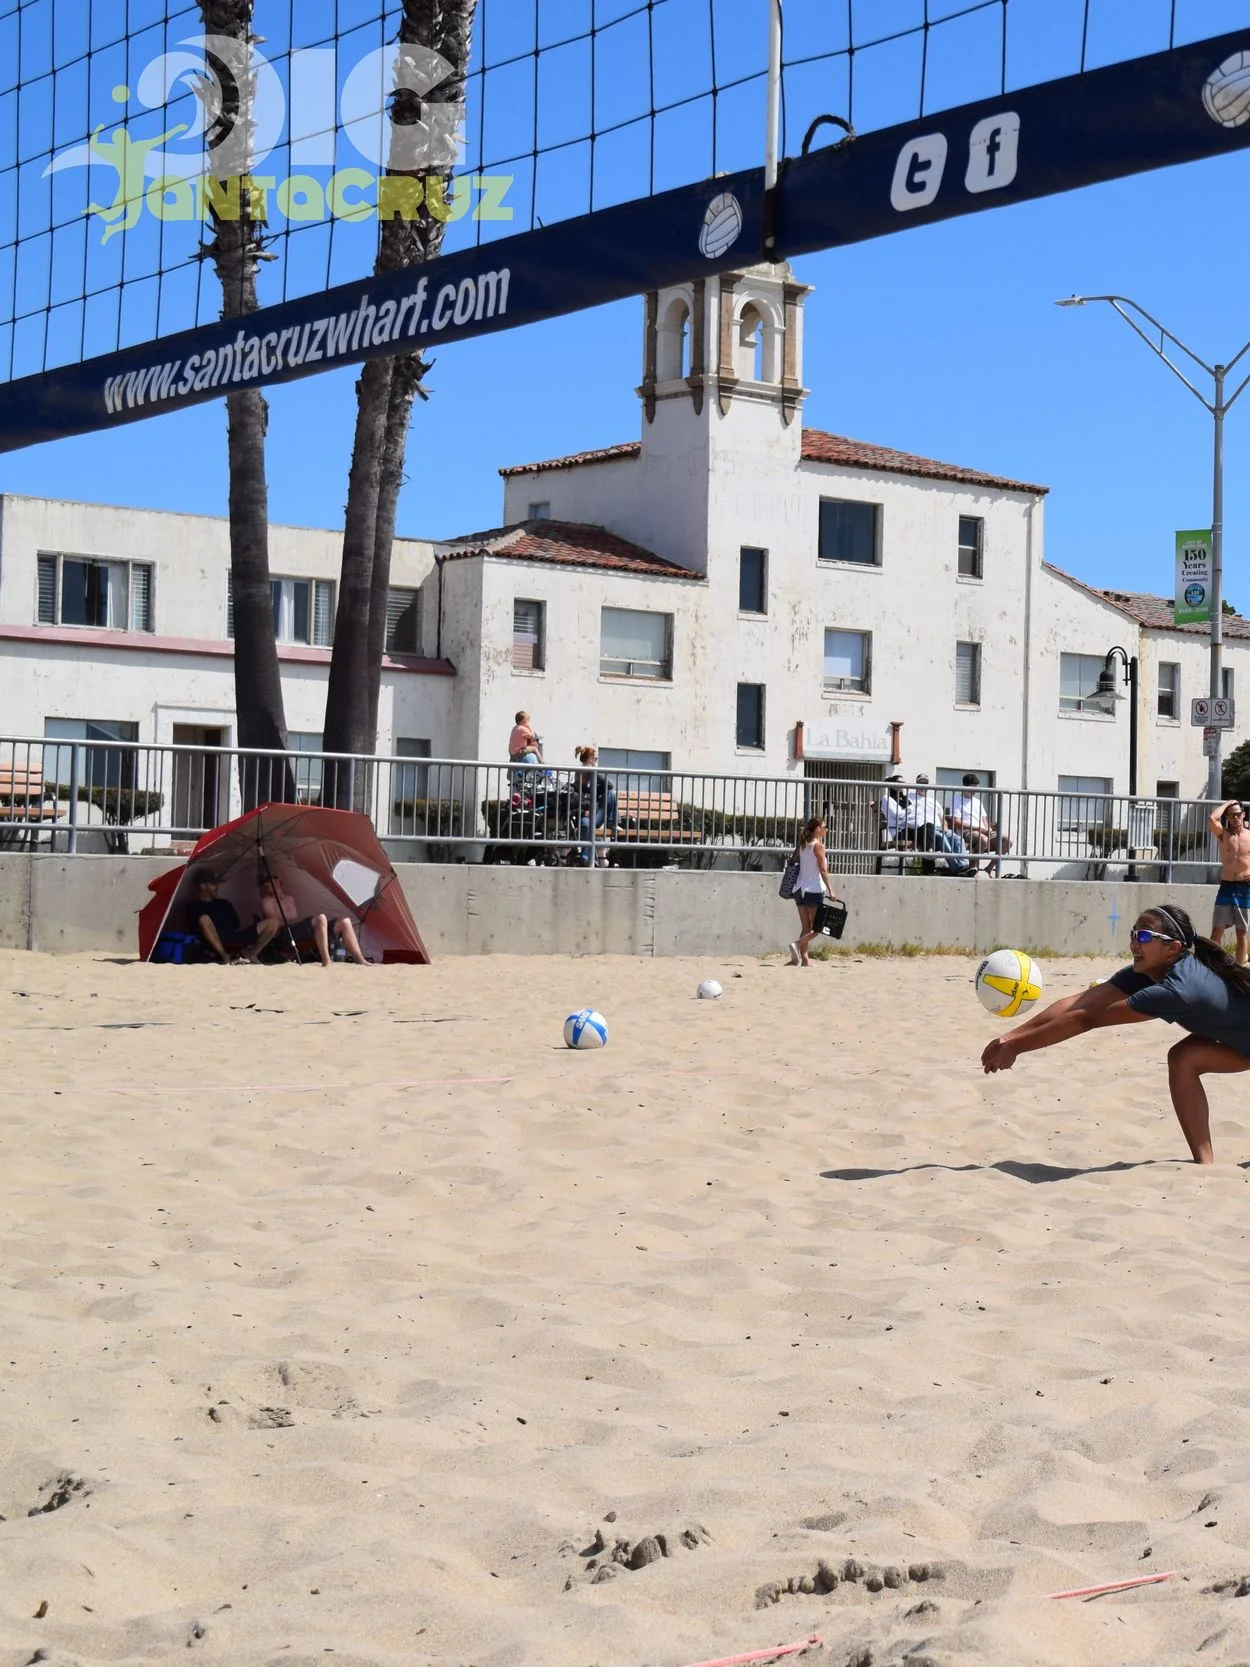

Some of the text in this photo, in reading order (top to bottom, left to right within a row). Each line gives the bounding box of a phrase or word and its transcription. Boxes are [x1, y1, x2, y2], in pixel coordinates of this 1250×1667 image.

[103, 267, 511, 415] www.santacruzwharf.com
[1184, 549, 1207, 561] 150
[1183, 561, 1206, 570] Years
[806, 728, 888, 750] La Bahia
